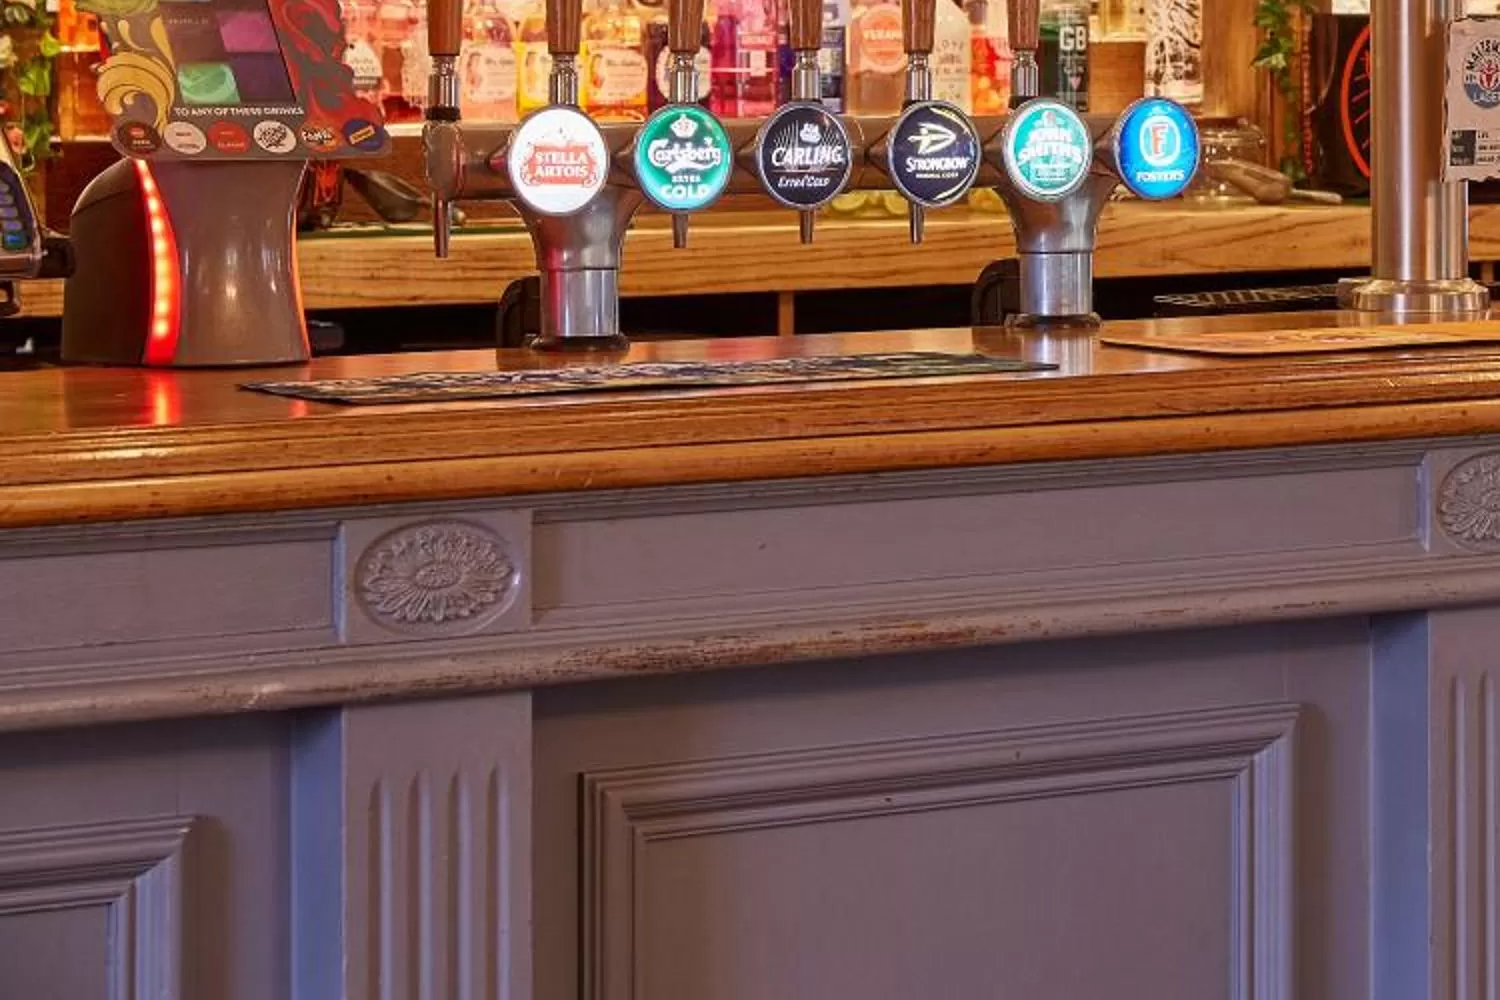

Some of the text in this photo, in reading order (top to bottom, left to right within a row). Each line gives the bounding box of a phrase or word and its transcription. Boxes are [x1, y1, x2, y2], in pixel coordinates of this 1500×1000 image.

[1059, 25, 1087, 52] GB
[190, 107, 213, 116] ANY
[535, 151, 588, 164] STELLA
[648, 136, 722, 168] Carlsberg
[771, 145, 844, 167] CARLING
[535, 165, 588, 178] ARTOIS
[660, 184, 711, 199] COLD
